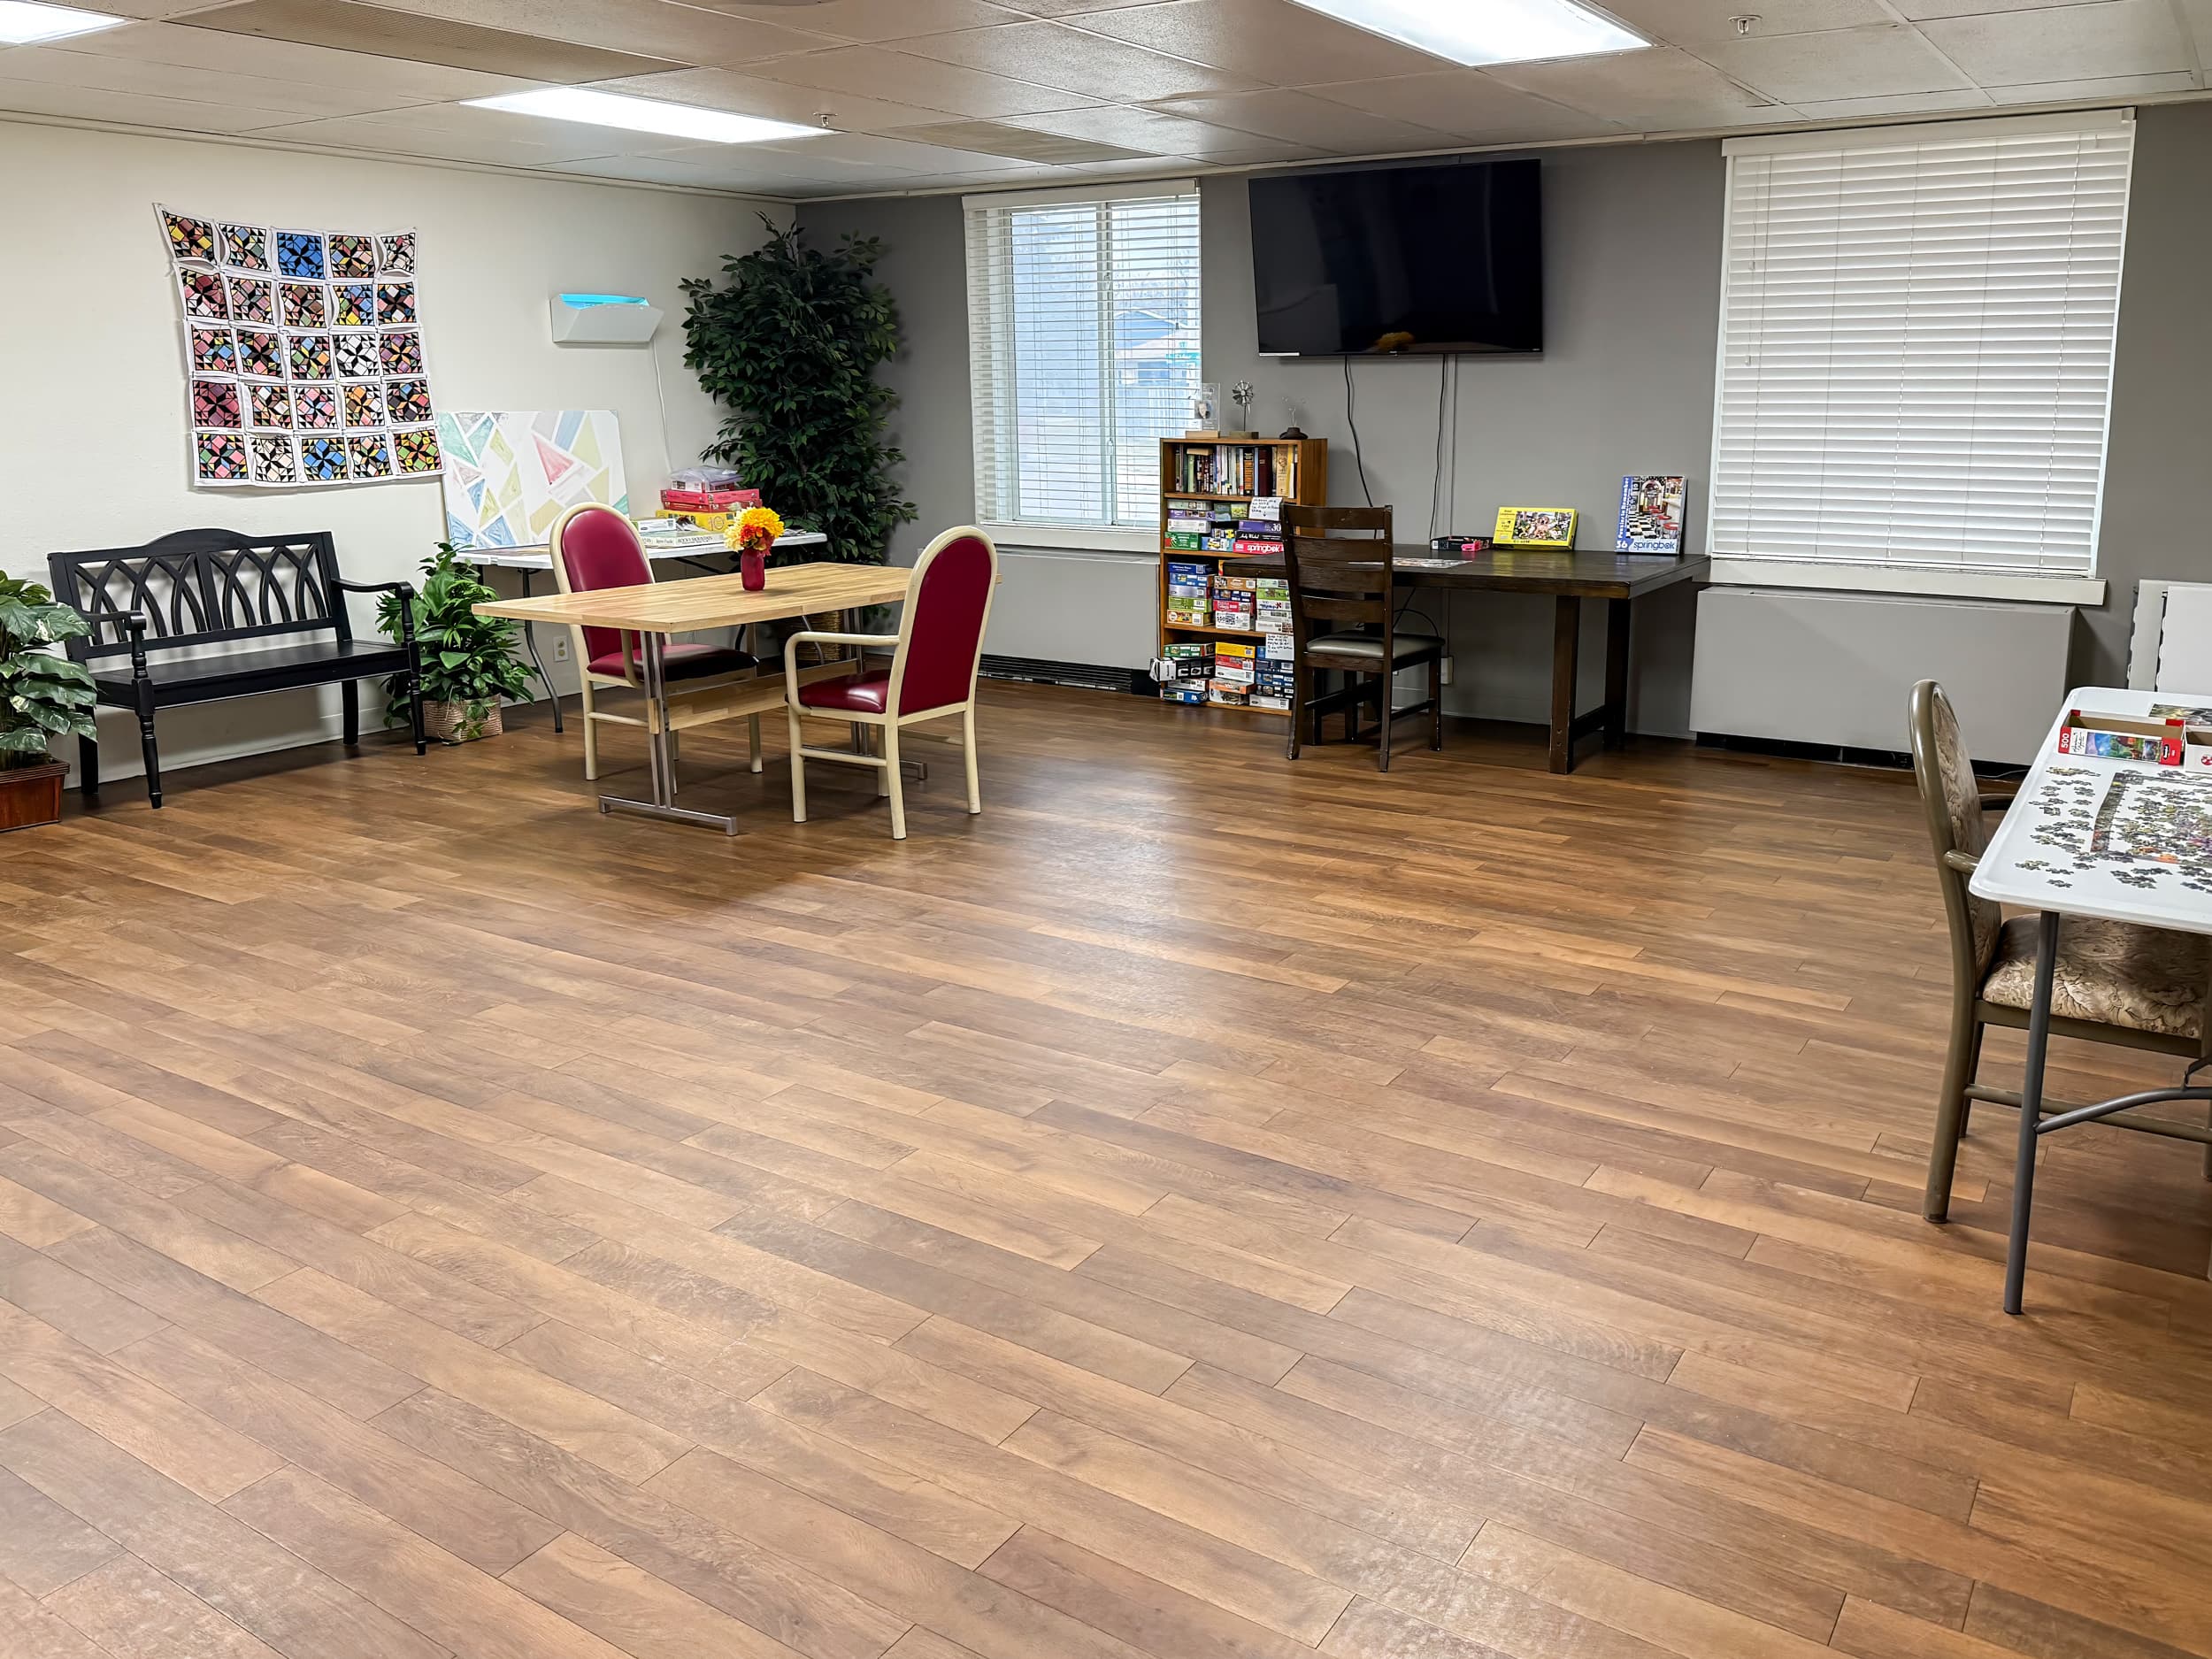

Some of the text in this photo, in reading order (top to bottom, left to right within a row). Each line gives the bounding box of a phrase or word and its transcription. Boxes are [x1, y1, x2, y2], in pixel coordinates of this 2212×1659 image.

[1248, 543, 1280, 553] springbok
[1633, 541, 1675, 550] springbok
[2061, 733, 2070, 749] 500
